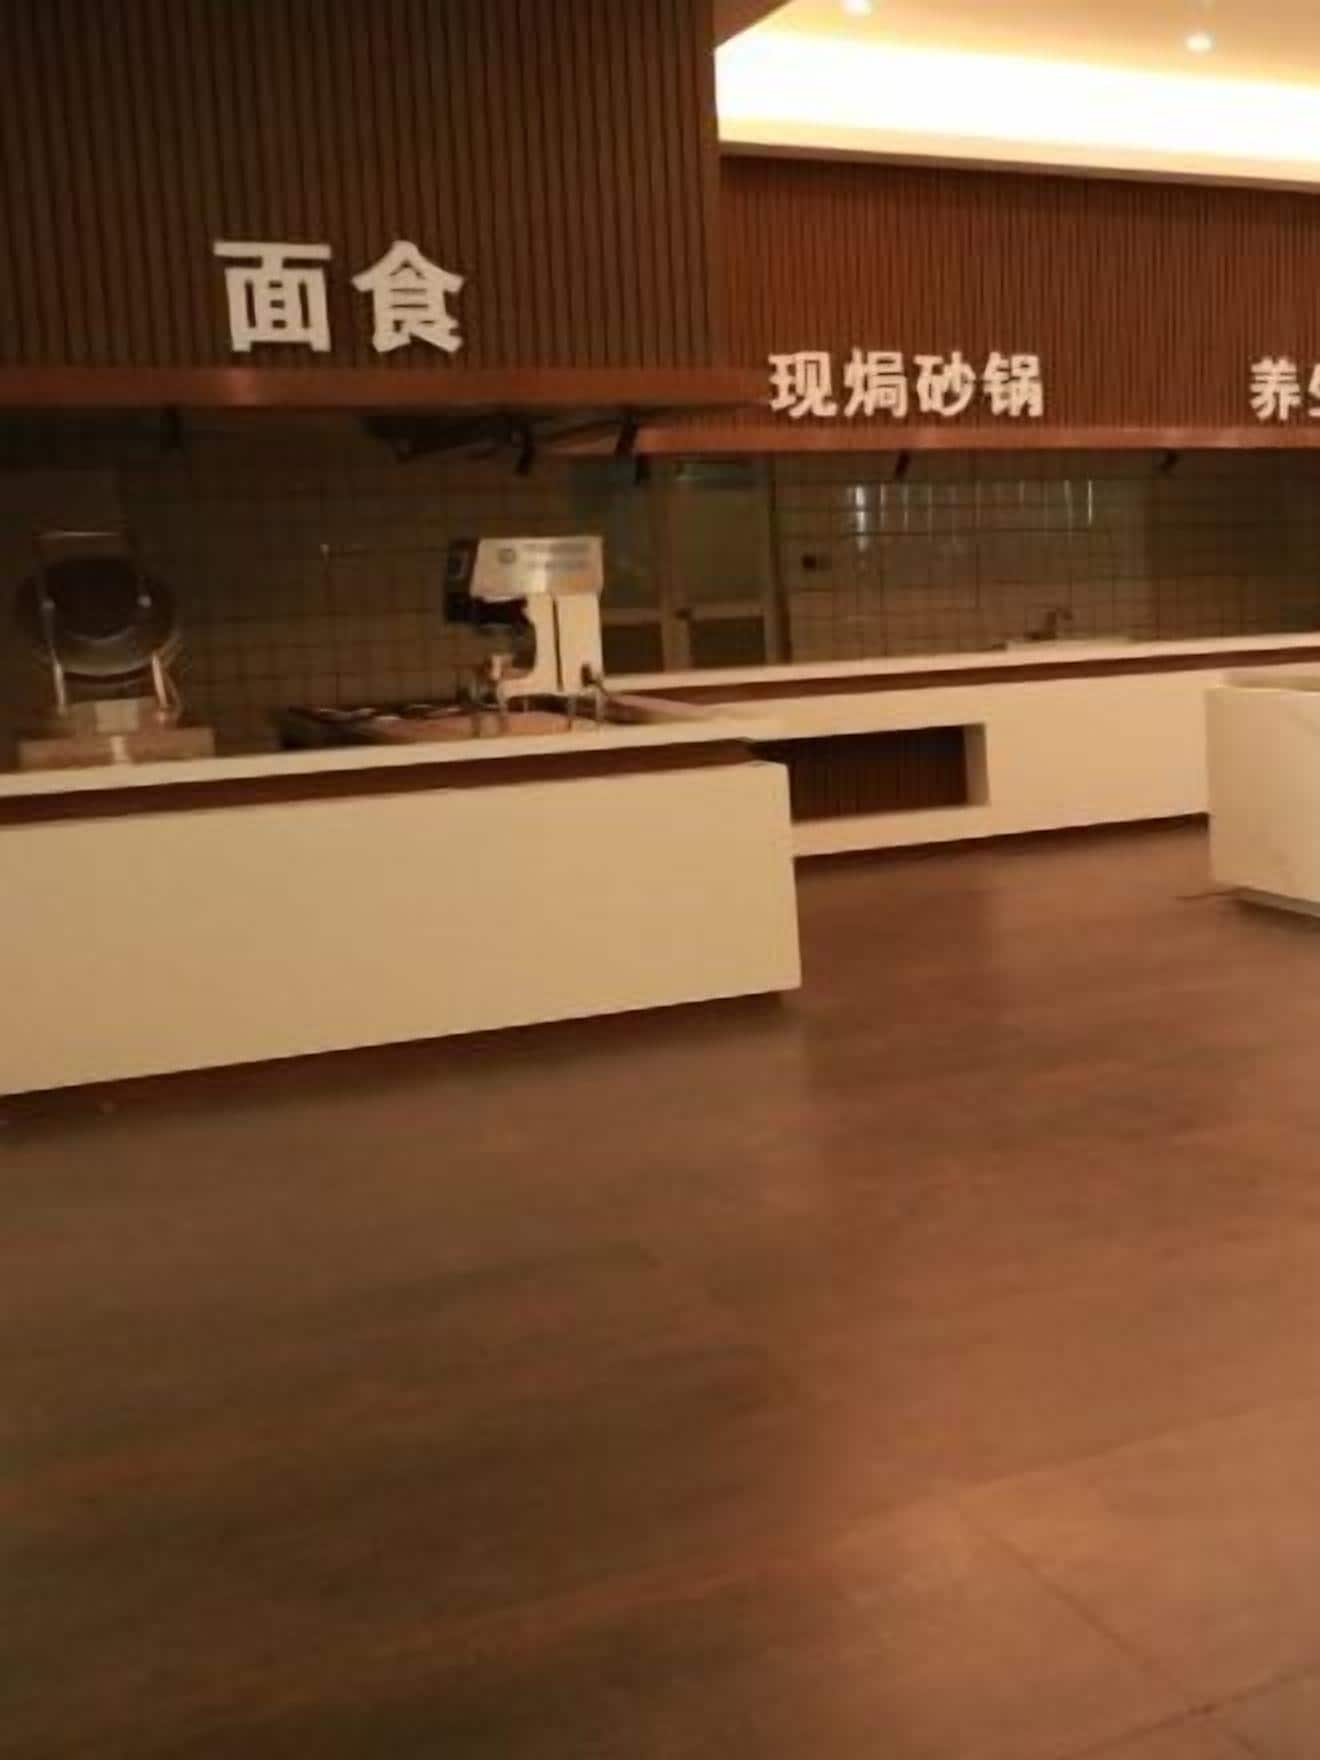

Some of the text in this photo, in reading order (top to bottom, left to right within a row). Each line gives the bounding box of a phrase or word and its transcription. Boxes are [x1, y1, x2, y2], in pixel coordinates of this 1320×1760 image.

[213, 240, 463, 353] 面食
[768, 348, 1043, 417] 现焗砂锅
